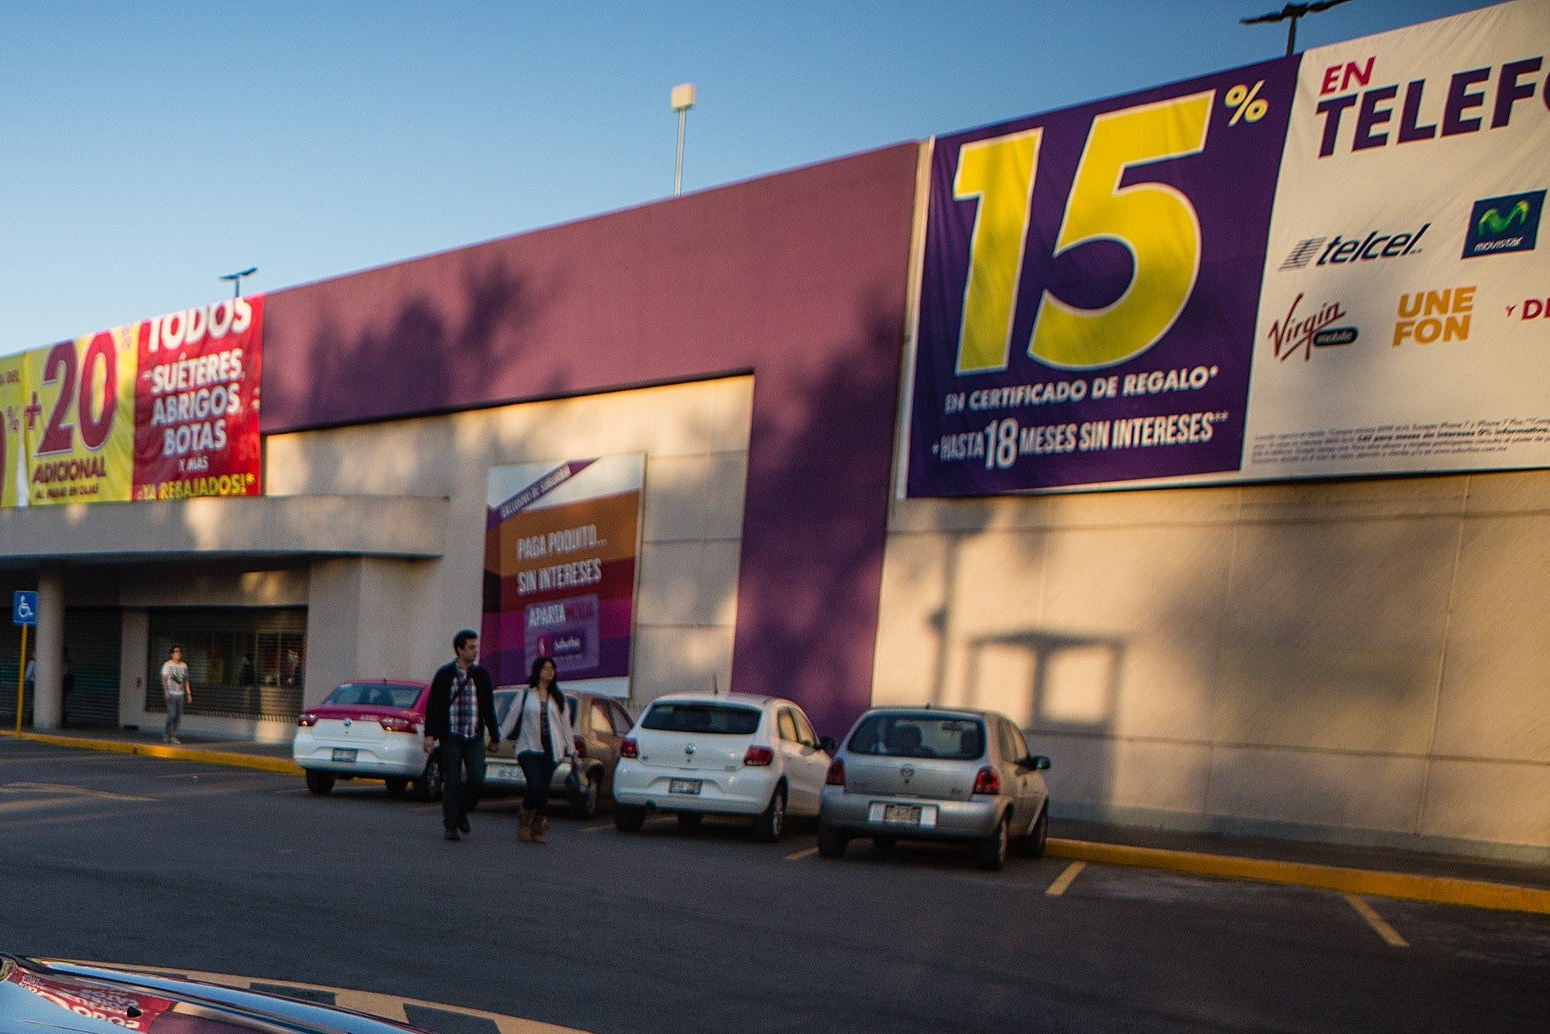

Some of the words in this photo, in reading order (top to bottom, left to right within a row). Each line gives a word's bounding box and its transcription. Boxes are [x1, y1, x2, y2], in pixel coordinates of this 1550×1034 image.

[1319, 56, 1376, 96] EN
[1315, 56, 1550, 159] TELEF
[1316, 222, 1432, 267] telcel
[1474, 236, 1524, 252] movistar
[1396, 285, 1477, 318] UNE
[149, 296, 252, 352] TODOS
[1268, 292, 1346, 362] Virgin
[1392, 315, 1471, 347] FON
[944, 392, 965, 414] EN
[969, 379, 1087, 411] CERTIFICADO
[1091, 375, 1119, 400] DE
[163, 421, 227, 458] BOTAS
[985, 418, 1020, 471] 18
[1019, 423, 1078, 456] MESES
[1078, 418, 1109, 451] SIN
[32, 456, 106, 484] ADICIONAL
[516, 535, 547, 561] PAGA
[516, 570, 538, 597] SIN
[538, 558, 602, 592] INTERESES
[528, 603, 567, 628] APARTA
